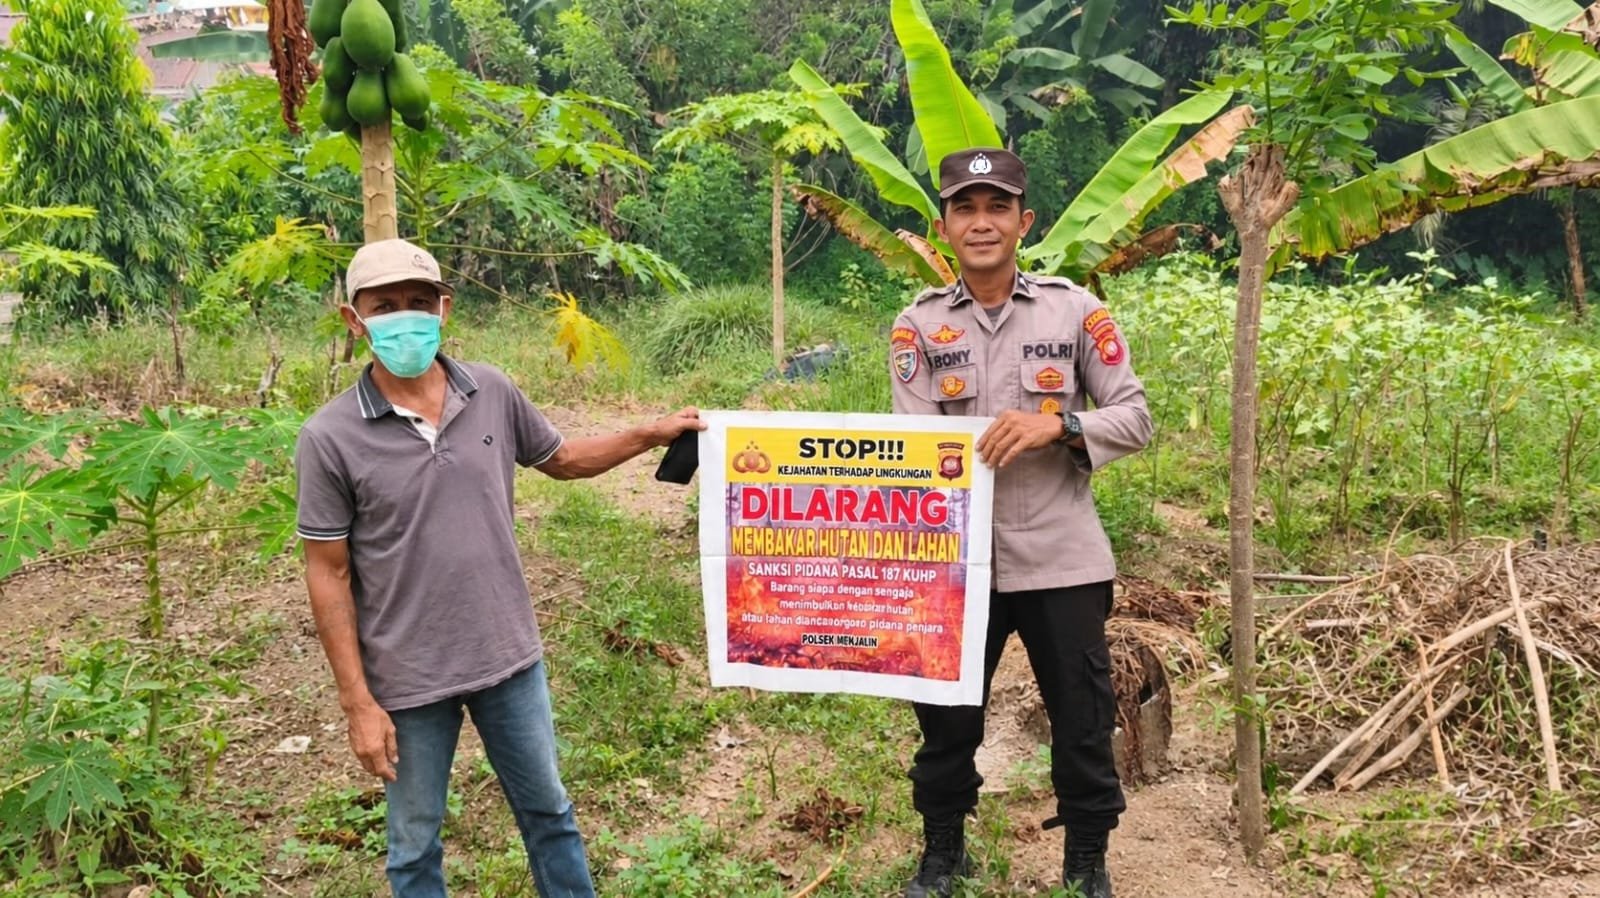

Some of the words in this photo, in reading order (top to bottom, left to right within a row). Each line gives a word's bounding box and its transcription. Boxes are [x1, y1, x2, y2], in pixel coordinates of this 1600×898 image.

[934, 349, 970, 368] BONY
[1023, 343, 1073, 359] POLRI
[799, 438, 904, 461] STOP!!!
[778, 465, 827, 476] KEJAHATAN
[829, 466, 873, 478] TERHADAP
[875, 468, 932, 479] LINGKUNGAN
[741, 487, 949, 526] DILARANG
[731, 526, 816, 557] MEMBAKAR
[818, 529, 873, 559] HUTAN
[875, 531, 907, 560] DAN
[909, 532, 960, 562] LAHAN
[748, 563, 791, 576] SANKSI
[794, 564, 839, 578] PIDANA
[842, 565, 879, 579] PASAL
[881, 567, 900, 581] 187
[903, 569, 937, 583] KUHP
[770, 582, 805, 595] Barang
[837, 584, 873, 597] dengan
[869, 619, 903, 632] pidana
[906, 622, 944, 635] penjara
[801, 634, 834, 645] POLSEK
